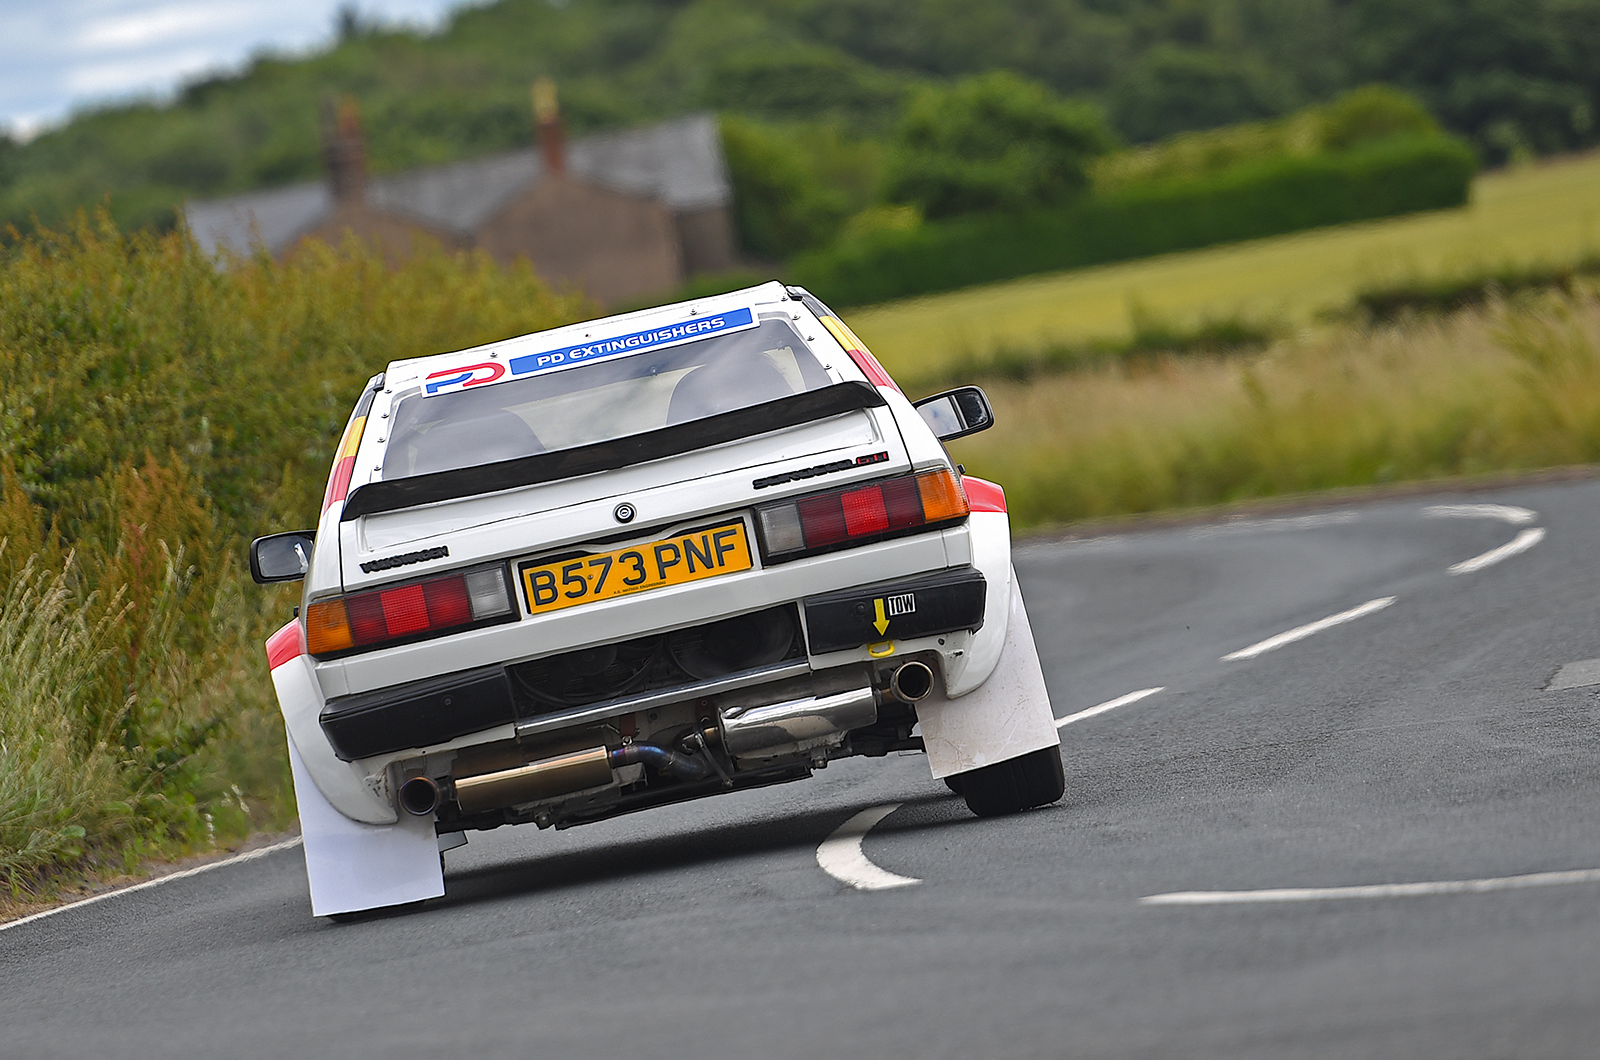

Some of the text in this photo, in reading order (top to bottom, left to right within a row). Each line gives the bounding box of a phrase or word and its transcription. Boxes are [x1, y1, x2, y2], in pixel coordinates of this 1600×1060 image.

[536, 317, 726, 367] PD EXTINGUISHERS
[359, 545, 450, 574] VOLKSWAGEN
[529, 528, 738, 607] B573 PNF
[888, 594, 914, 615] TOW
